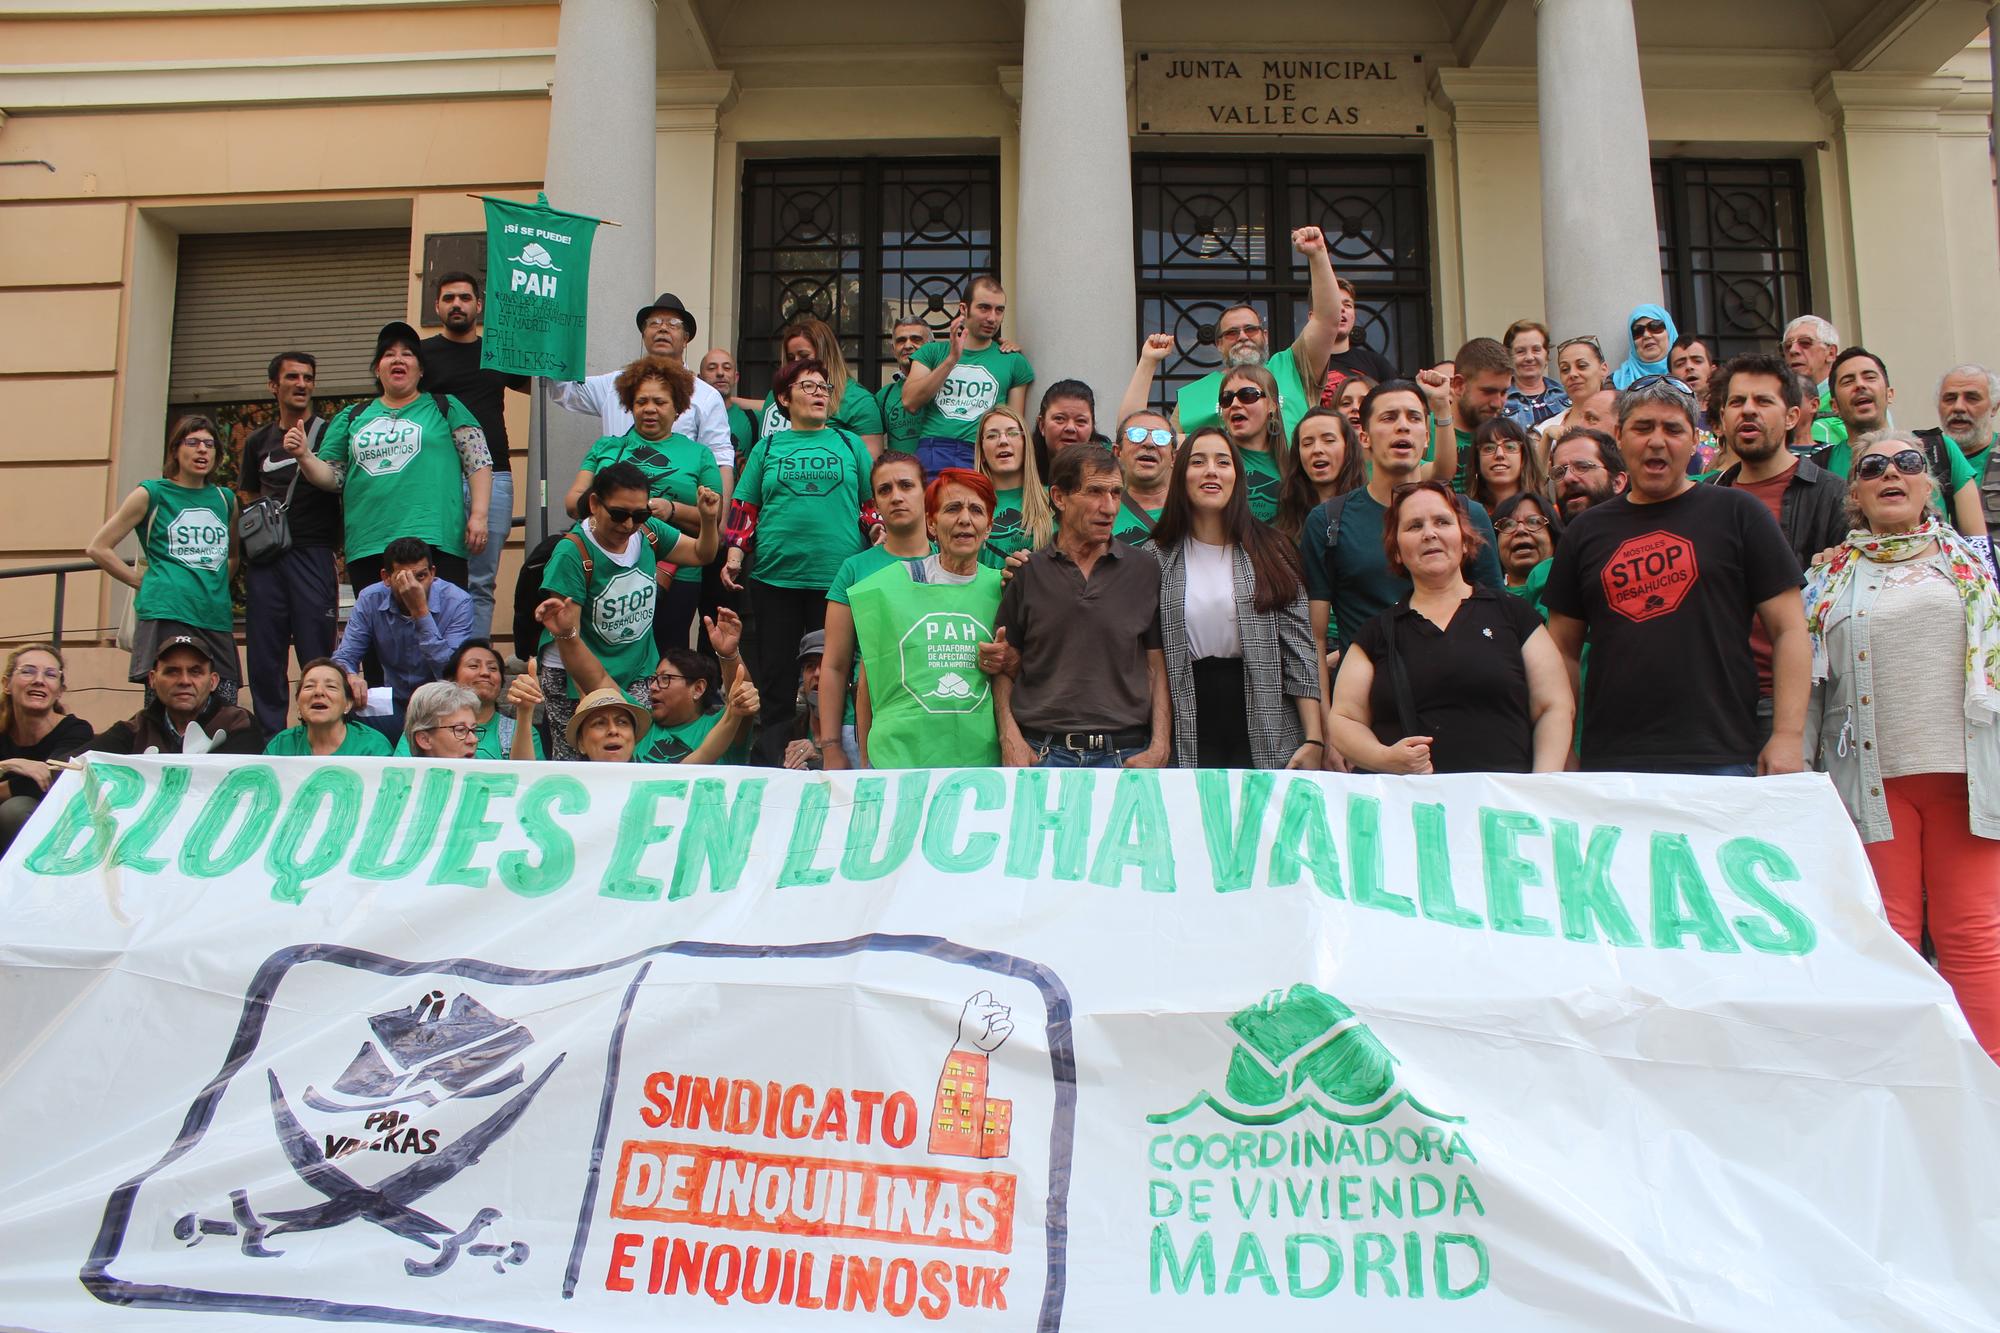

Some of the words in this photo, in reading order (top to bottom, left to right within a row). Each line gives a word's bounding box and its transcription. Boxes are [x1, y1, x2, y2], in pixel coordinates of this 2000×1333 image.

[1165, 61, 1242, 79] JUNTA
[1262, 61, 1398, 80] MUNICIPAL
[1265, 83, 1296, 101] DE
[1207, 105, 1360, 125] VALLECAS
[520, 226, 535, 237] SE
[536, 229, 572, 245] PUEDE!
[511, 268, 558, 299] PAH
[486, 327, 515, 348] PAH
[943, 378, 993, 398] STOP
[939, 398, 990, 409] DESAHUCIOS
[358, 427, 415, 449] STOP
[359, 444, 414, 462] DESAHUCIOS
[783, 456, 839, 471] STOP
[782, 470, 839, 481] DESAHUCIOS
[176, 525, 226, 545] STOP
[1611, 544, 1683, 588] STOP
[1616, 569, 1688, 603] DESAHUCIOS
[601, 585, 654, 620] STOP
[601, 607, 654, 632] DESAHUCIOS
[926, 622, 976, 641] PAH
[927, 644, 976, 653] PLATAFORMA
[928, 653, 937, 661] DE
[938, 653, 976, 662] AFECTADOS
[949, 661, 976, 669] HIPOTECA
[24, 763, 592, 906] BLOQUES
[598, 777, 768, 902] EN
[775, 768, 1177, 894] LUCHA
[1194, 768, 1819, 957] VALLEKAS
[639, 1070, 918, 1149] SINDICATO
[1149, 1124, 1478, 1172] COORDINADORA
[621, 1151, 697, 1211] DE
[700, 1156, 998, 1243] INQUILINAS
[1149, 1178, 1214, 1223] DE
[1231, 1172, 1486, 1222] VIVIENDA
[1149, 1222, 1490, 1301] MADRID
[605, 1233, 645, 1293] E
[648, 1236, 953, 1321] INQUILINOS
[955, 1263, 1011, 1312] VK
